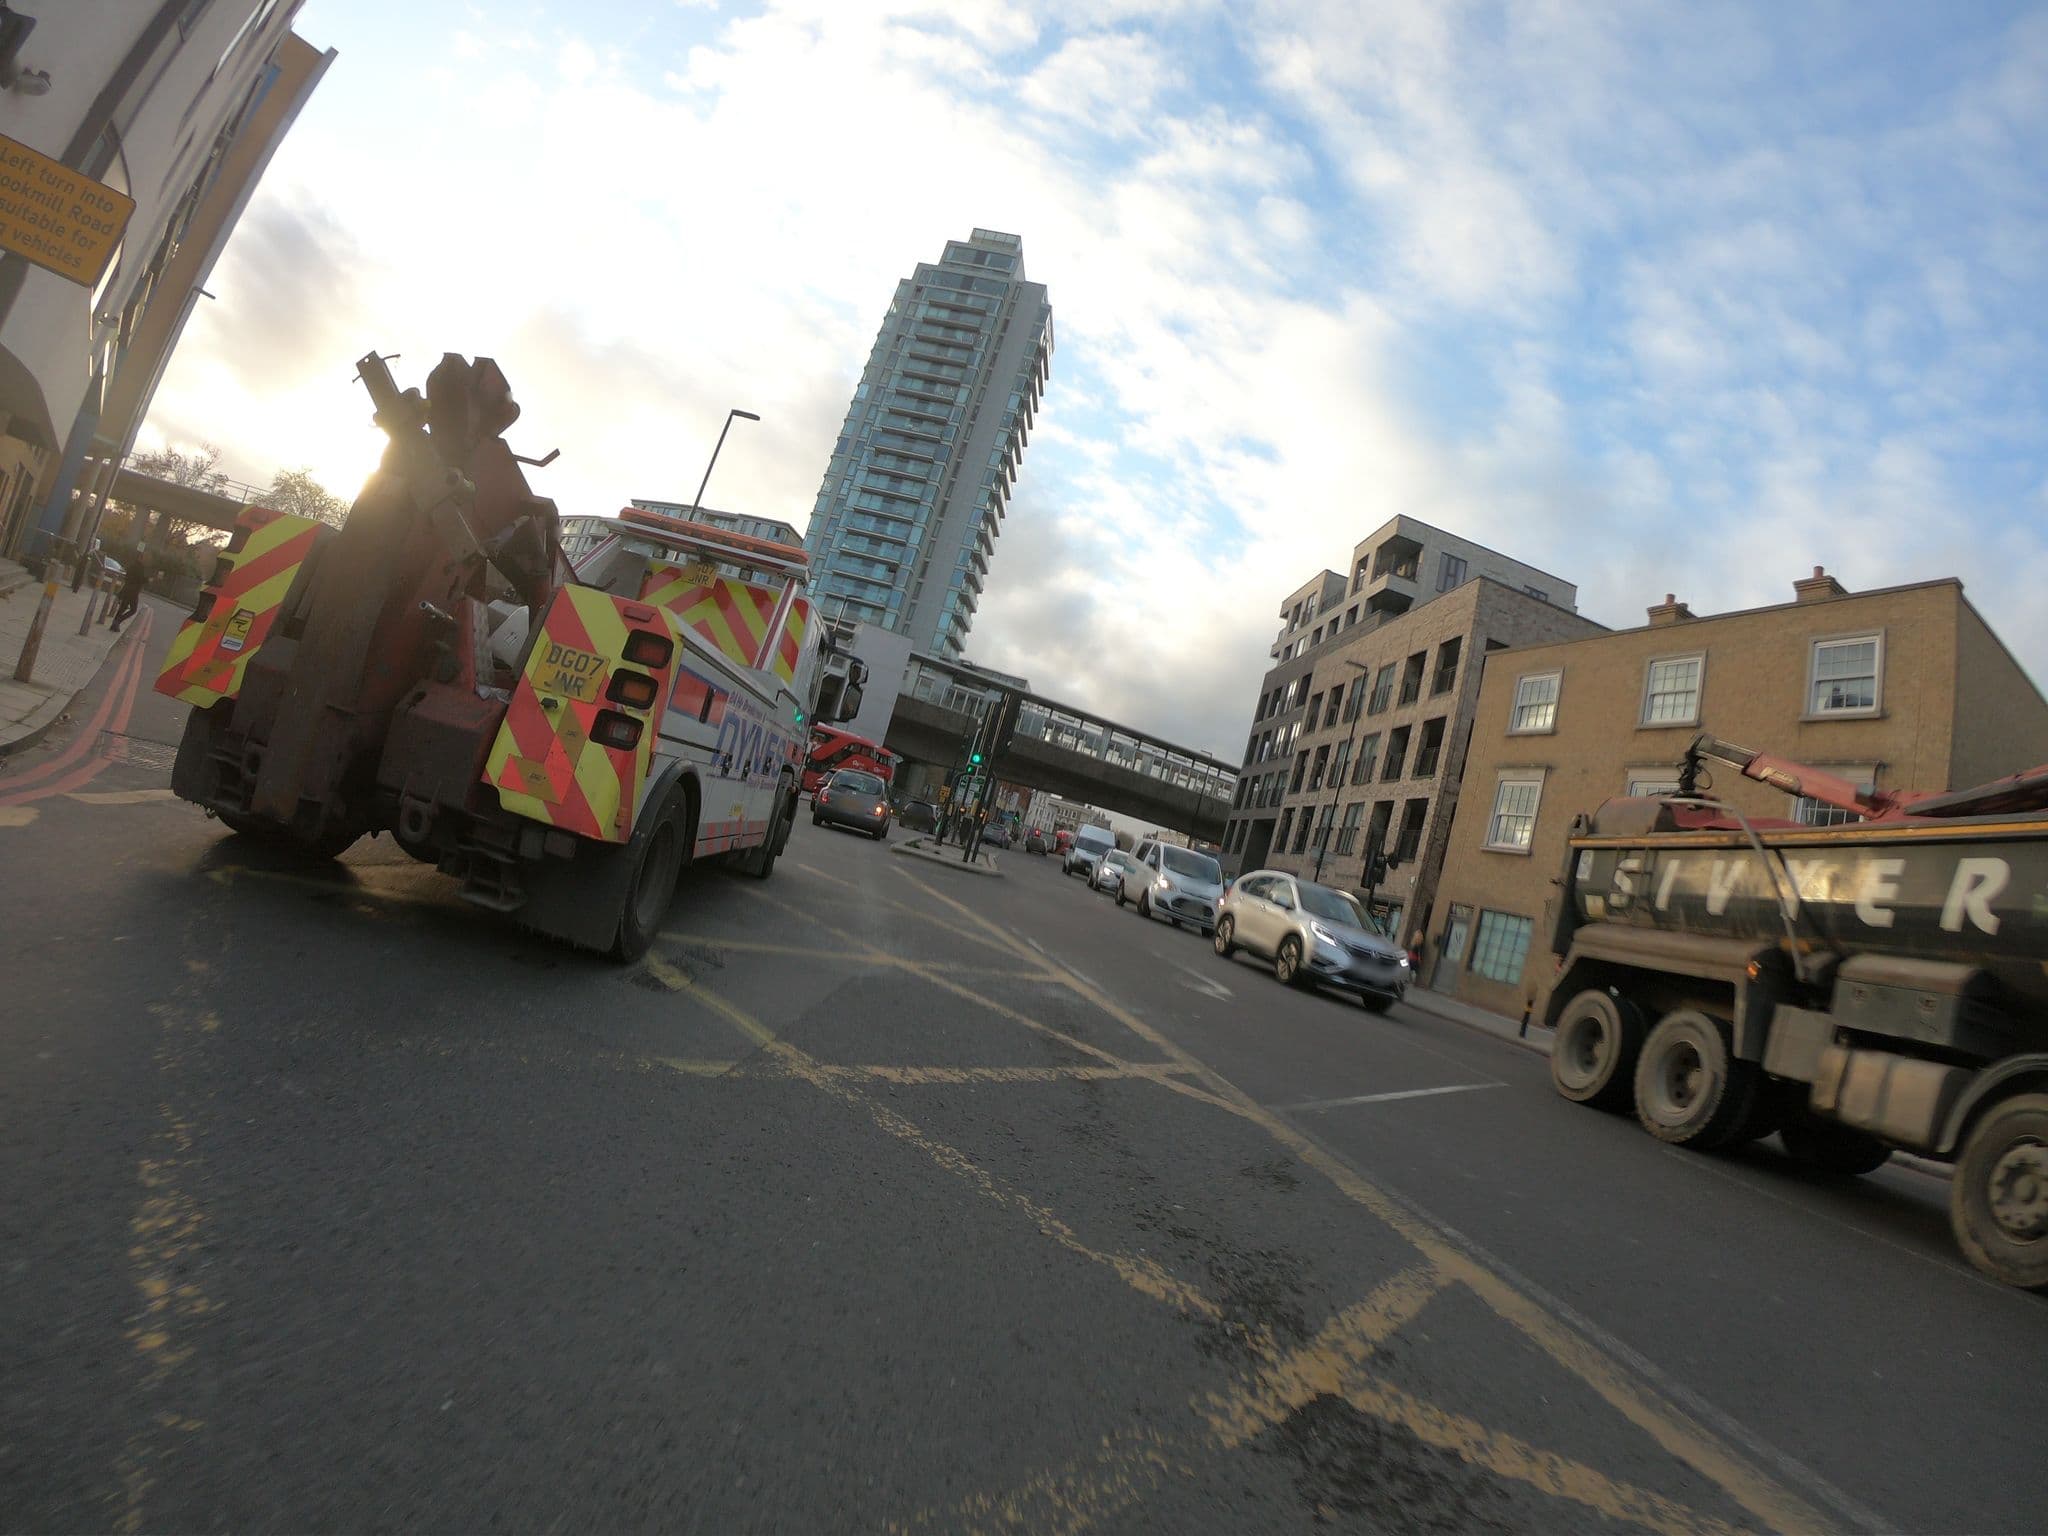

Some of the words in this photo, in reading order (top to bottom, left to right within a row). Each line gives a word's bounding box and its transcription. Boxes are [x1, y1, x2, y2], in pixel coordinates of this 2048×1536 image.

[0, 147, 36, 175] Left
[40, 168, 75, 194] turn
[80, 186, 114, 213] into
[68, 205, 114, 236] Road
[13, 228, 82, 268] vehicles
[72, 229, 98, 250] for
[546, 642, 605, 676] DG07
